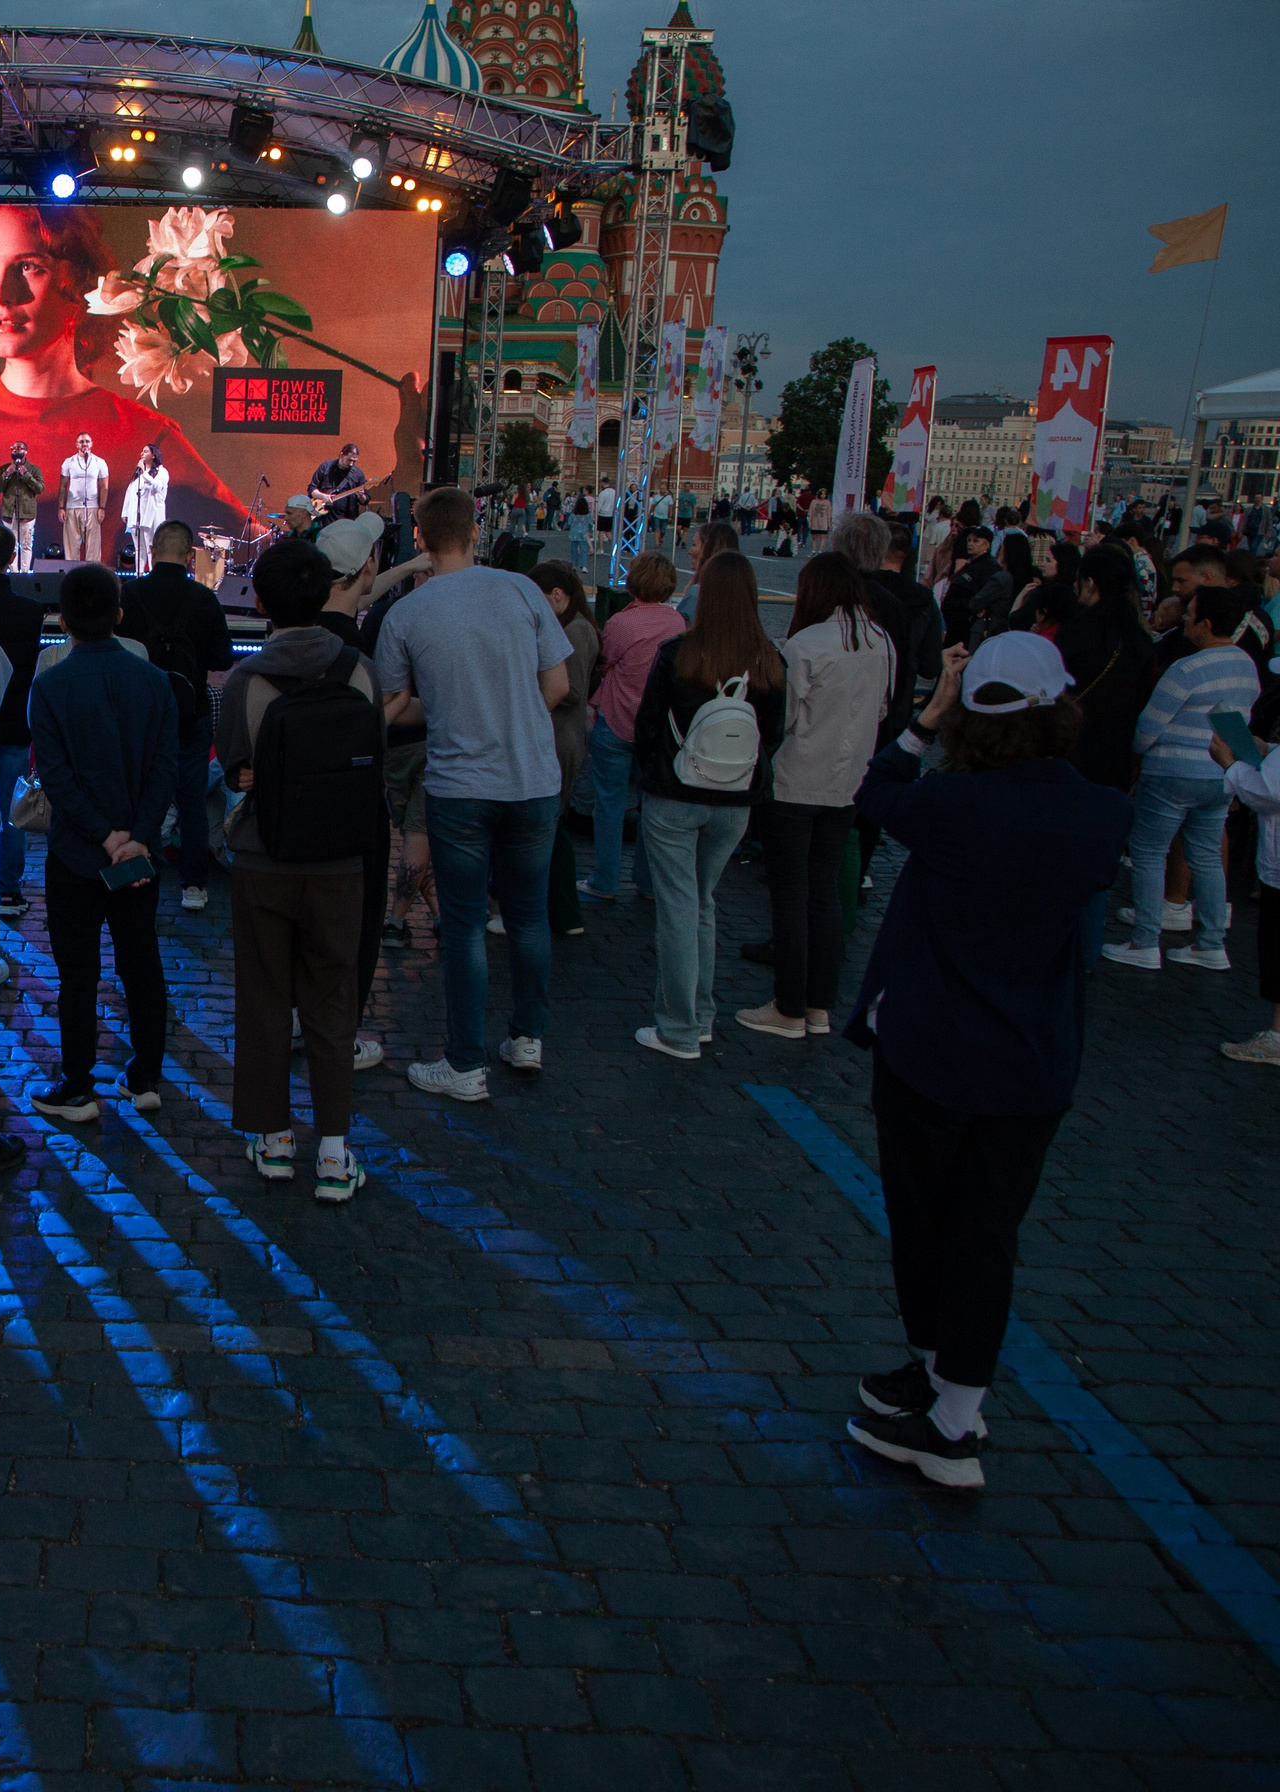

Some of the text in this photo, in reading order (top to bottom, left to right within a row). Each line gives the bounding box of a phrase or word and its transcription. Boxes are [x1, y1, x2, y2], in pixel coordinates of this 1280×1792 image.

[667, 32, 702, 41] PROLYTE
[271, 380, 326, 394] POWER
[271, 393, 328, 411] GOSPEL
[270, 409, 327, 422] SINGERS
